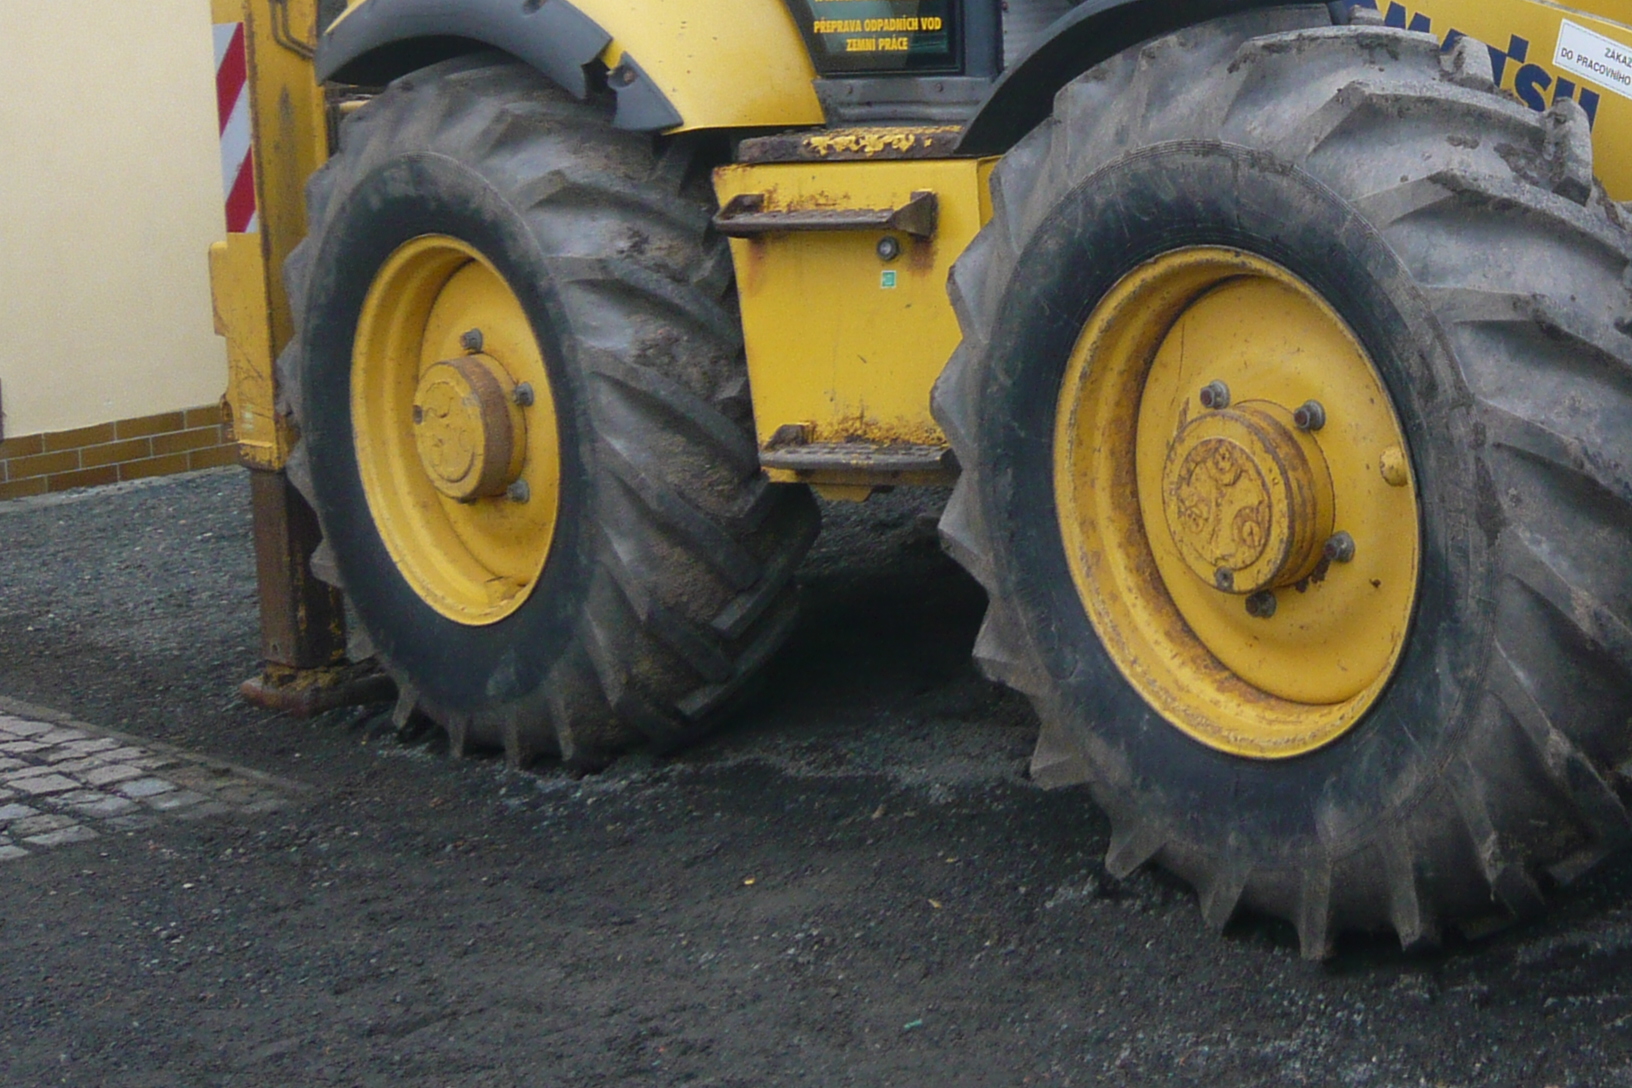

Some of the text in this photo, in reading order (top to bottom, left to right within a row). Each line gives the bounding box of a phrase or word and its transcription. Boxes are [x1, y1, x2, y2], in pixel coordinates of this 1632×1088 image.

[813, 16, 862, 33] PŘEPRAVA
[921, 16, 942, 31] VOD
[878, 34, 909, 50] PRÁCE
[1560, 47, 1574, 61] DO
[1576, 55, 1632, 87] PRACOVNÍHO
